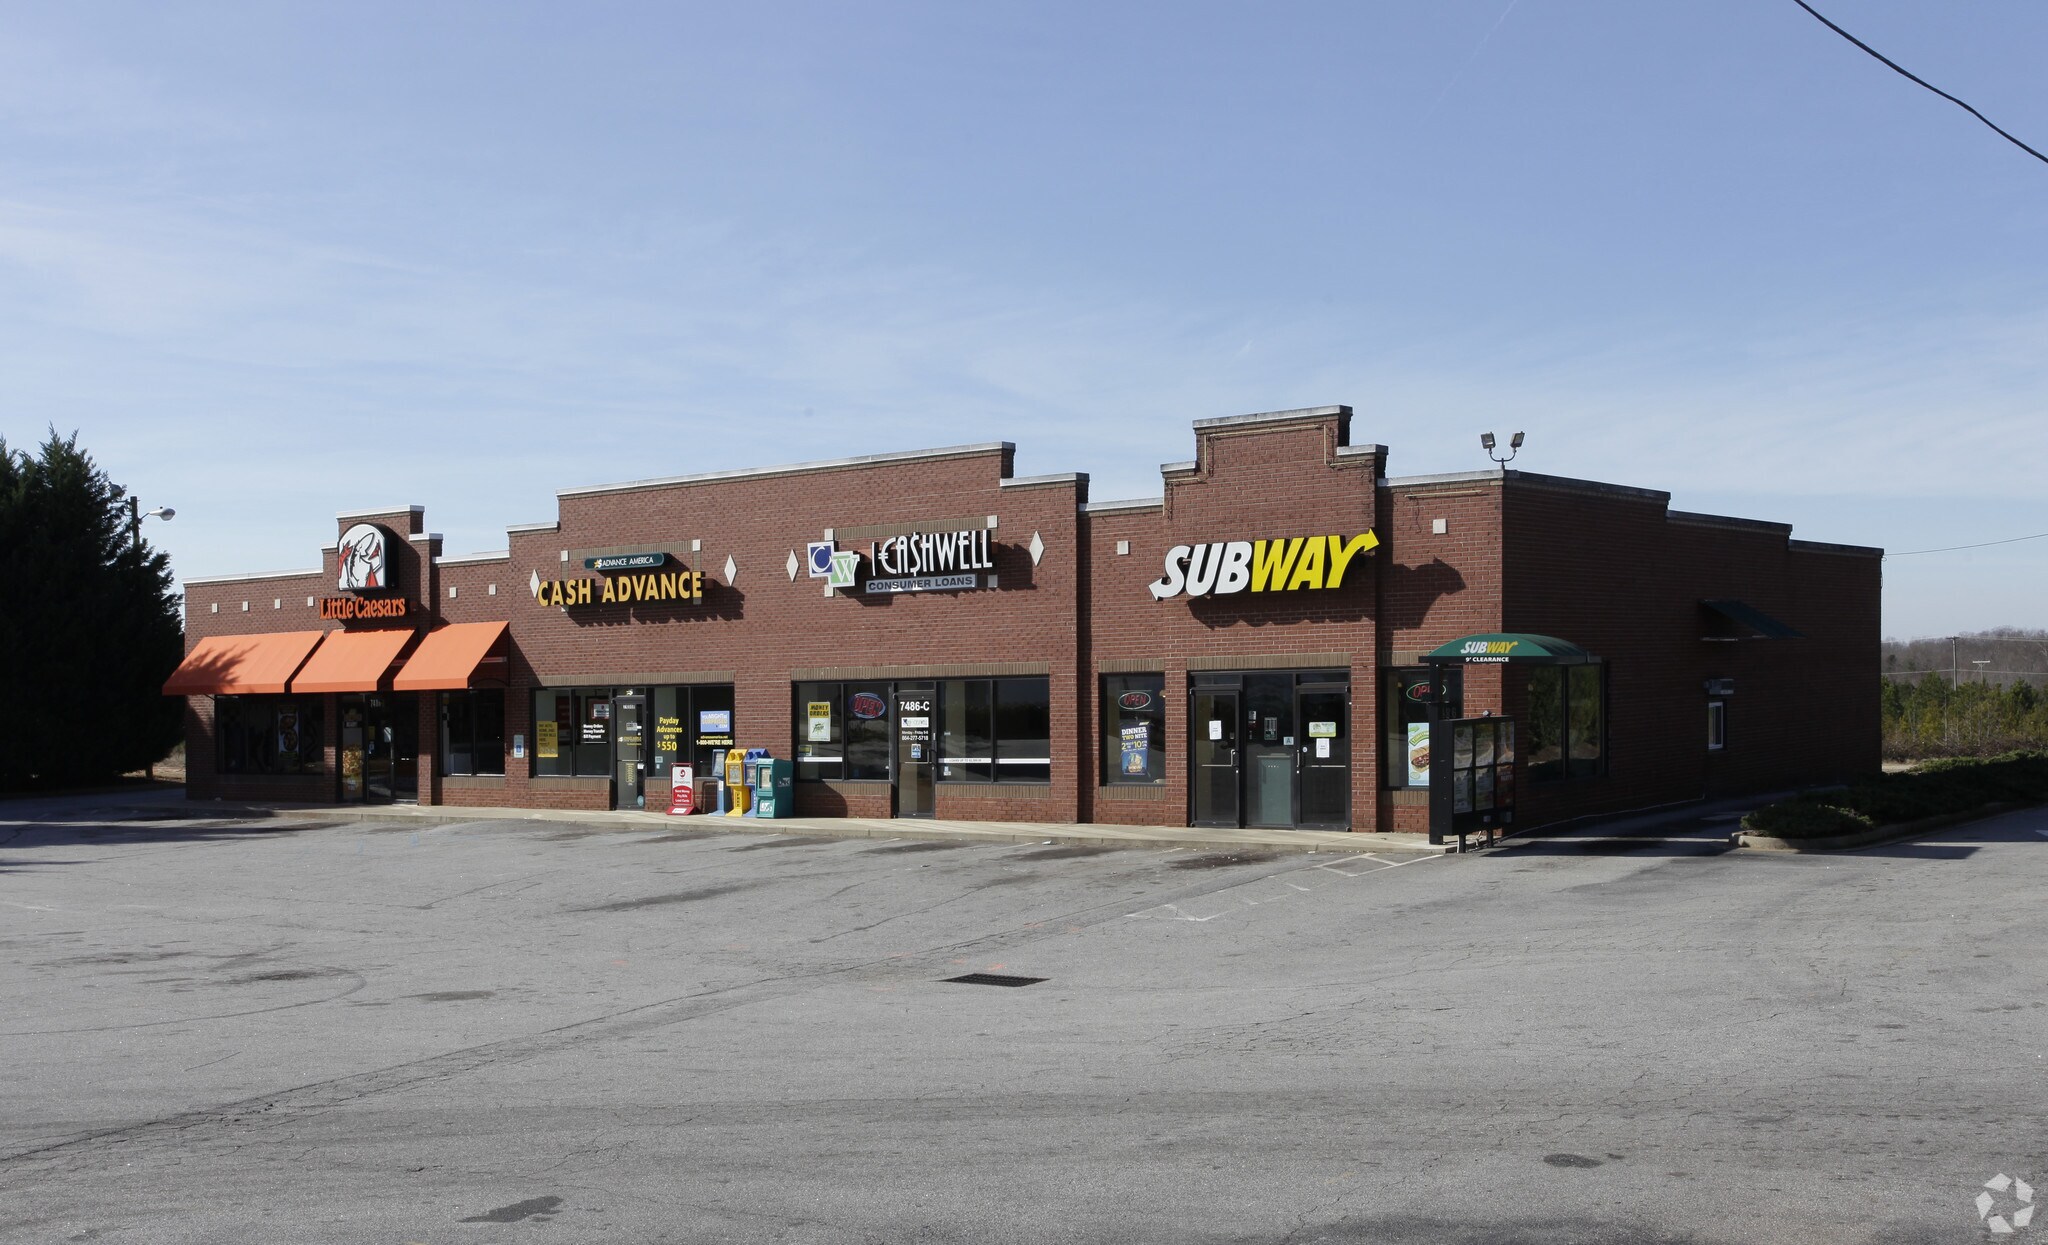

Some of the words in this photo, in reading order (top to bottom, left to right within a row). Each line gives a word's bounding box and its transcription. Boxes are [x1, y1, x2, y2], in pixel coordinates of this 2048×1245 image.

[602, 557, 627, 567] ADVANCE
[629, 556, 654, 565] AMERICA
[1149, 528, 1380, 601] SUBWAY
[537, 578, 592, 607] CASH
[601, 571, 703, 603] ADVANCE
[868, 579, 932, 591] CONSUMER
[935, 576, 973, 587] LOANS
[319, 596, 354, 620] Little
[354, 596, 406, 619] Caesars
[1460, 641, 1519, 654] SUBWAY
[1123, 694, 1147, 706] OPEN
[854, 695, 882, 717] OPEN
[900, 701, 930, 711] 7486-C
[659, 717, 680, 726] Payday
[656, 725, 683, 734] Advances
[1121, 726, 1147, 735] DINNER
[657, 741, 678, 751] $550
[1121, 742, 1127, 750] 2
